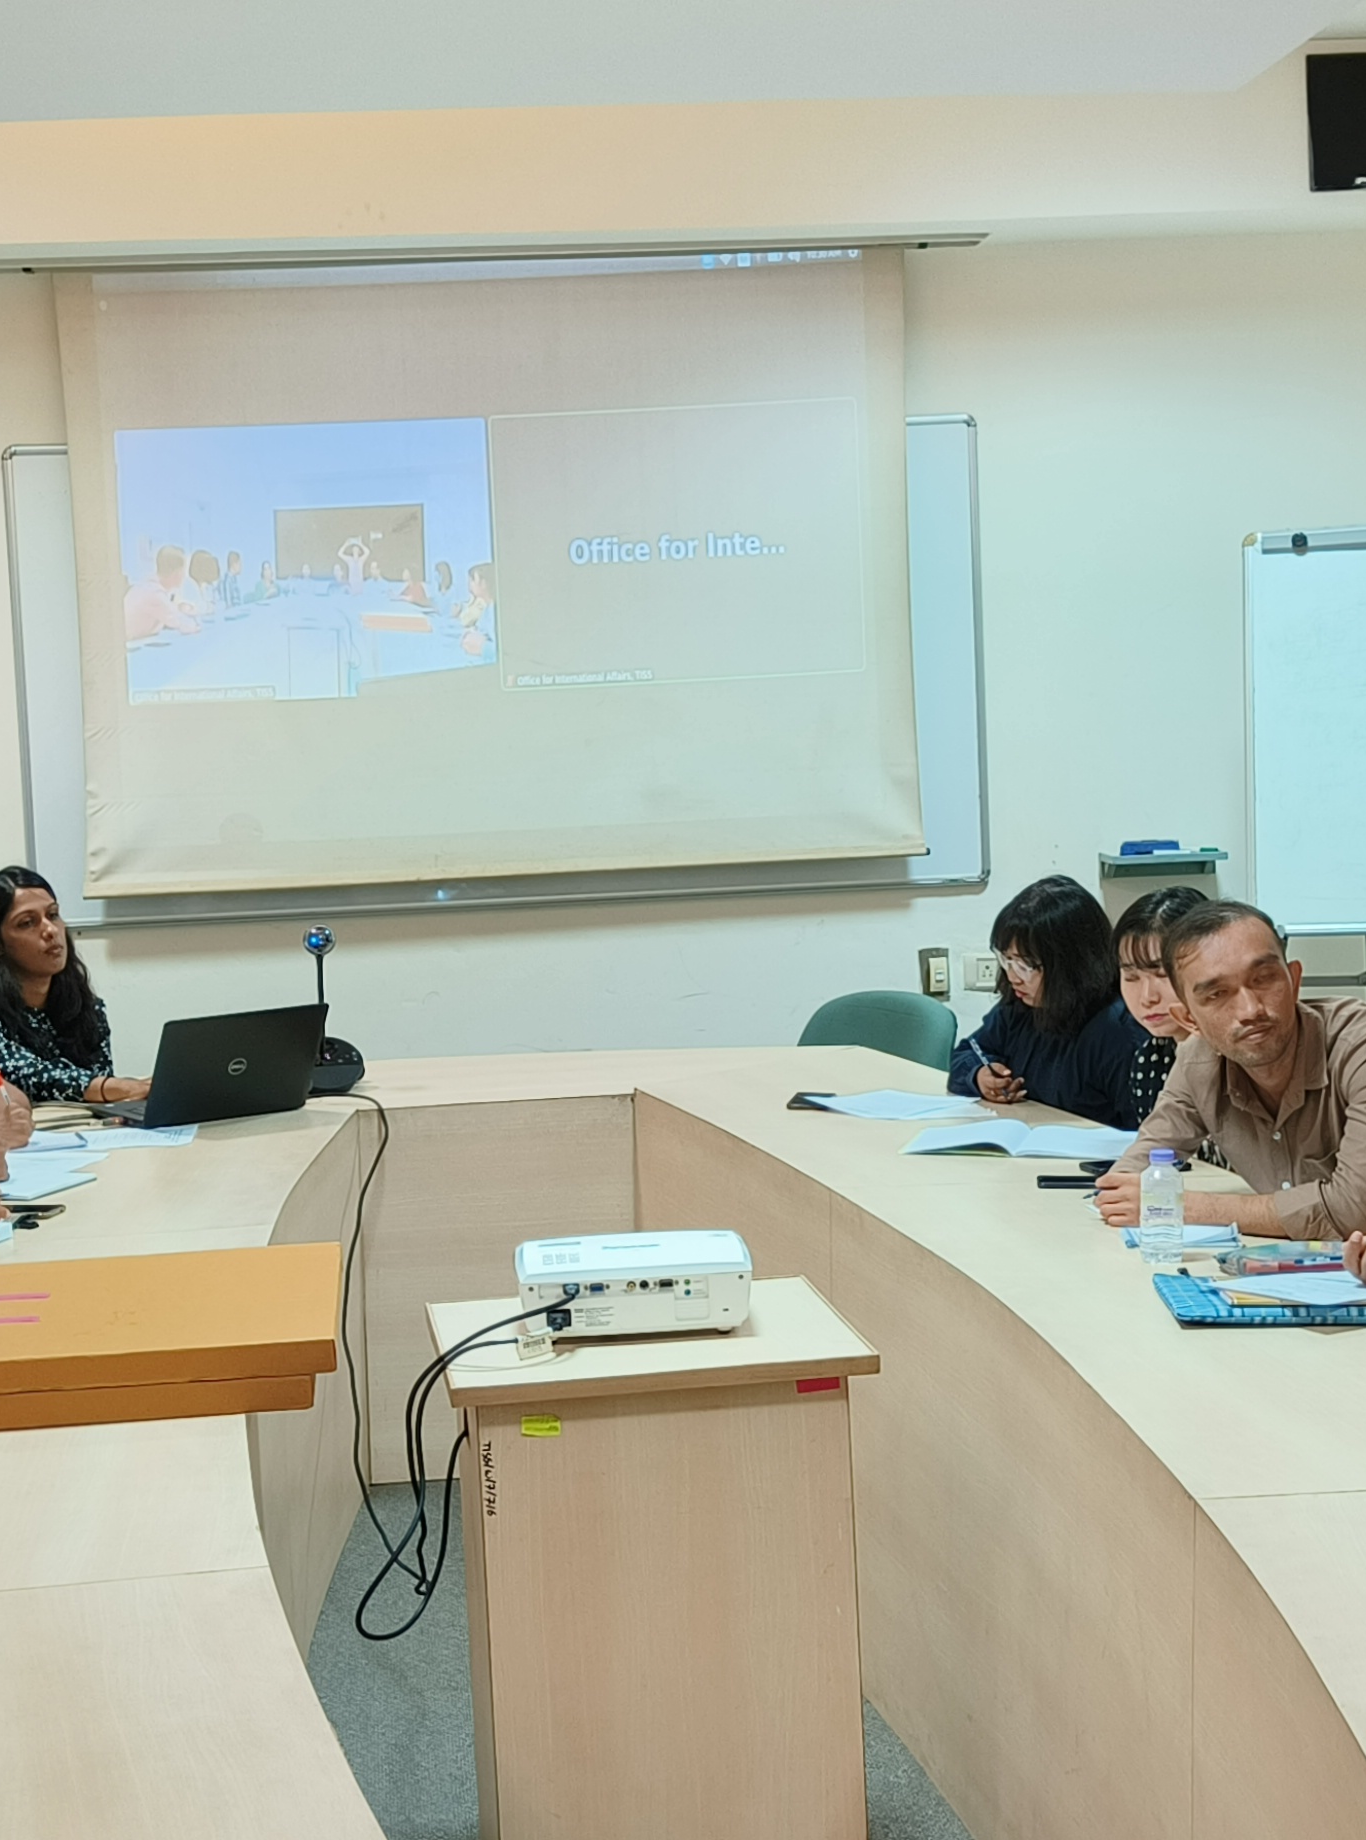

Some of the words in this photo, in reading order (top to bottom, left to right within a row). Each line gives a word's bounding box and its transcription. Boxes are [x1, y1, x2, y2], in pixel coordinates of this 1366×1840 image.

[569, 537, 650, 564] Office
[658, 533, 699, 560] for
[517, 674, 541, 686] Office
[542, 673, 553, 684] for
[555, 671, 604, 684] International
